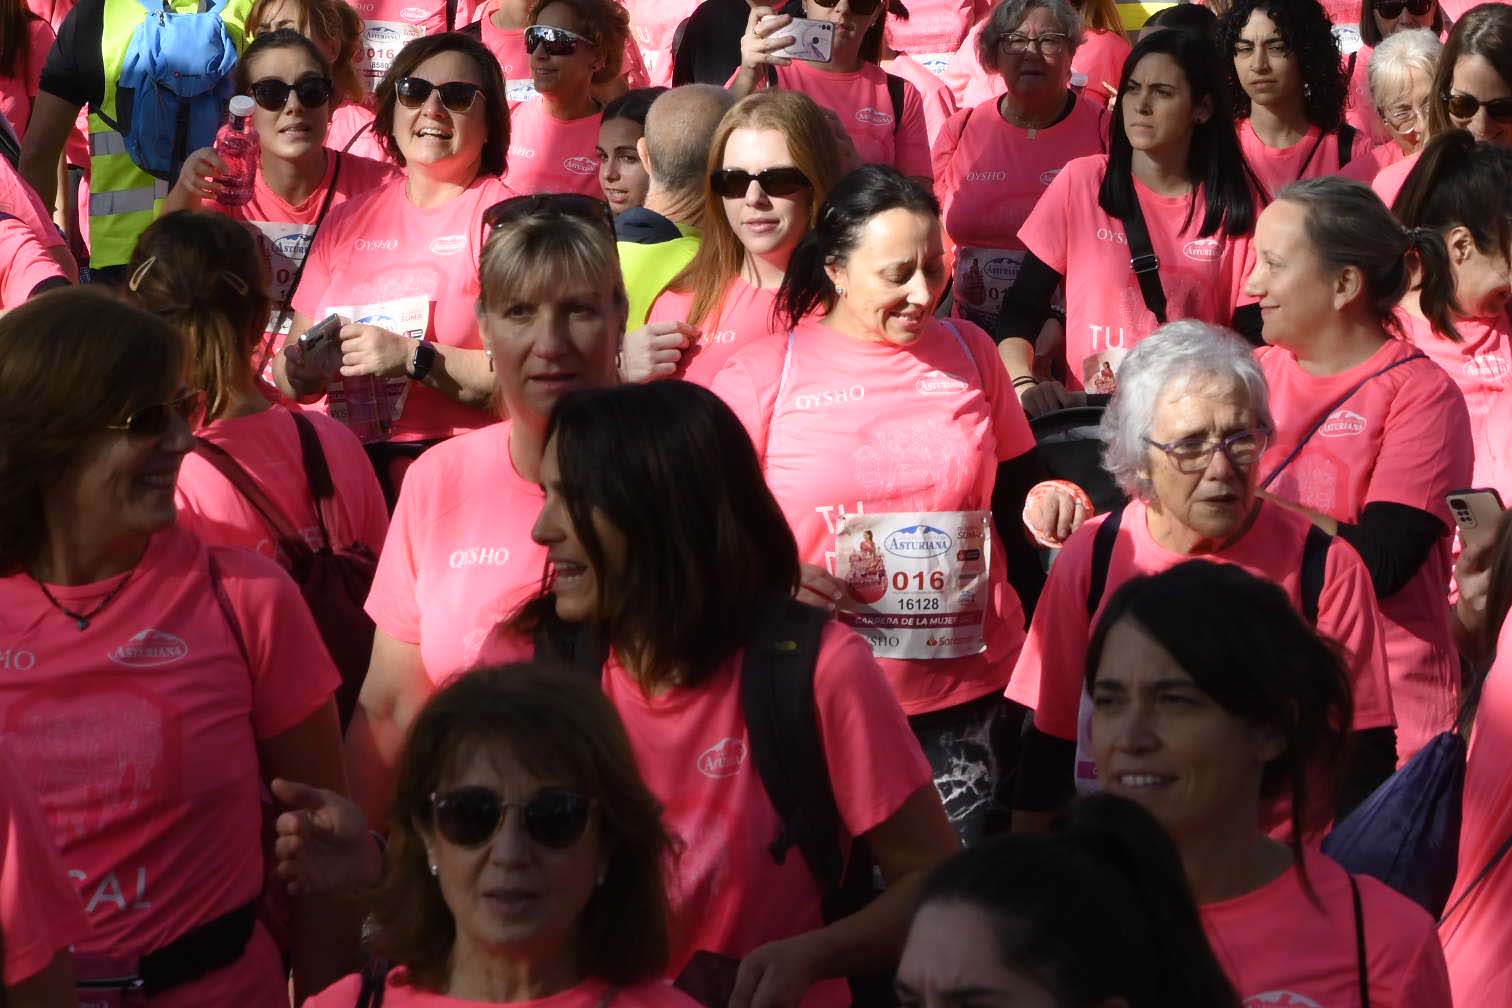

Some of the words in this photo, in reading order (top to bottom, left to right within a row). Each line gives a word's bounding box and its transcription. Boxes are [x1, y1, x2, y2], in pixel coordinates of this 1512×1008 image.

[1088, 324, 1125, 350] TU
[795, 384, 865, 411] OYSHO
[889, 538, 948, 551] ASTURIANA
[892, 570, 945, 591] 016
[898, 598, 939, 610] 16128
[901, 616, 914, 625] DE
[916, 615, 927, 625] LA
